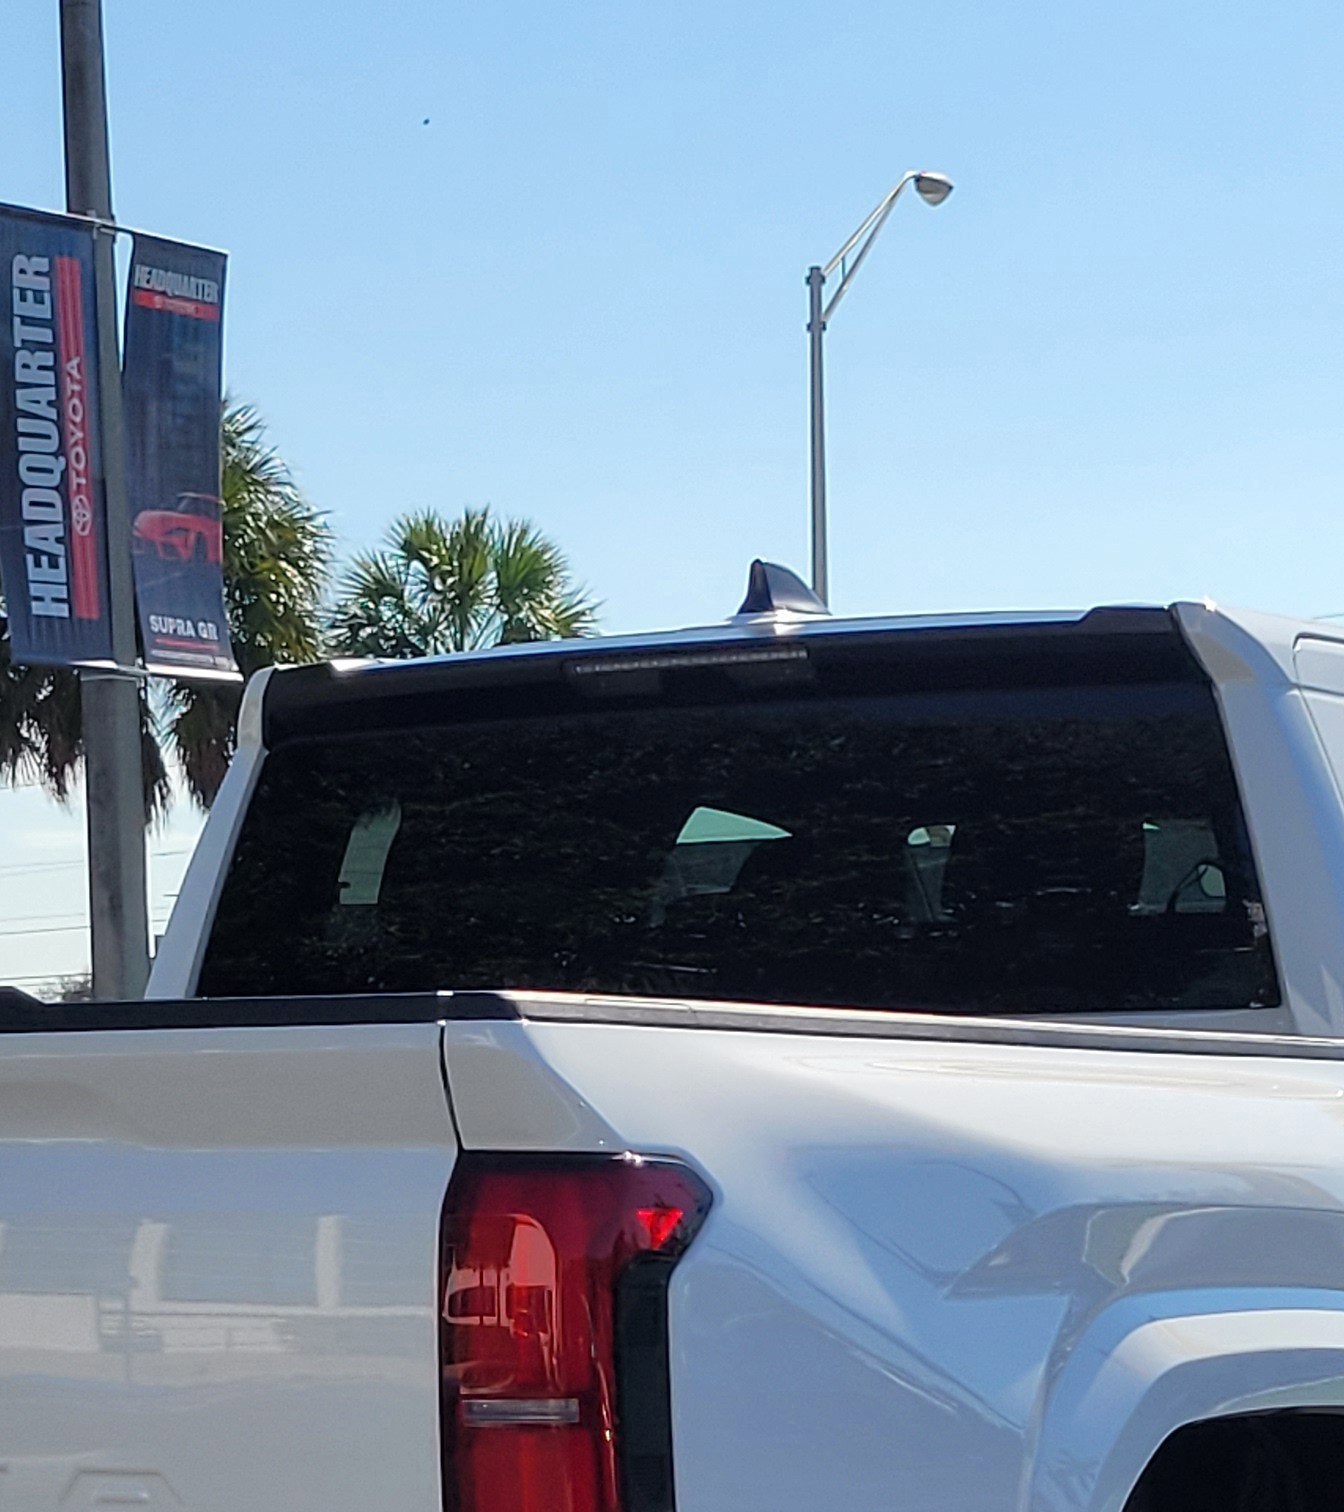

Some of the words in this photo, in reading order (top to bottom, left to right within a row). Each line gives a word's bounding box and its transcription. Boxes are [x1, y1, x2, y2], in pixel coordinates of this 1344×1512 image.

[133, 264, 220, 303] HEADQUARTER
[12, 253, 70, 619] HEADQUARTER
[63, 356, 88, 487] TOYOTA
[149, 614, 197, 638] SUPRA
[197, 621, 219, 640] GR
